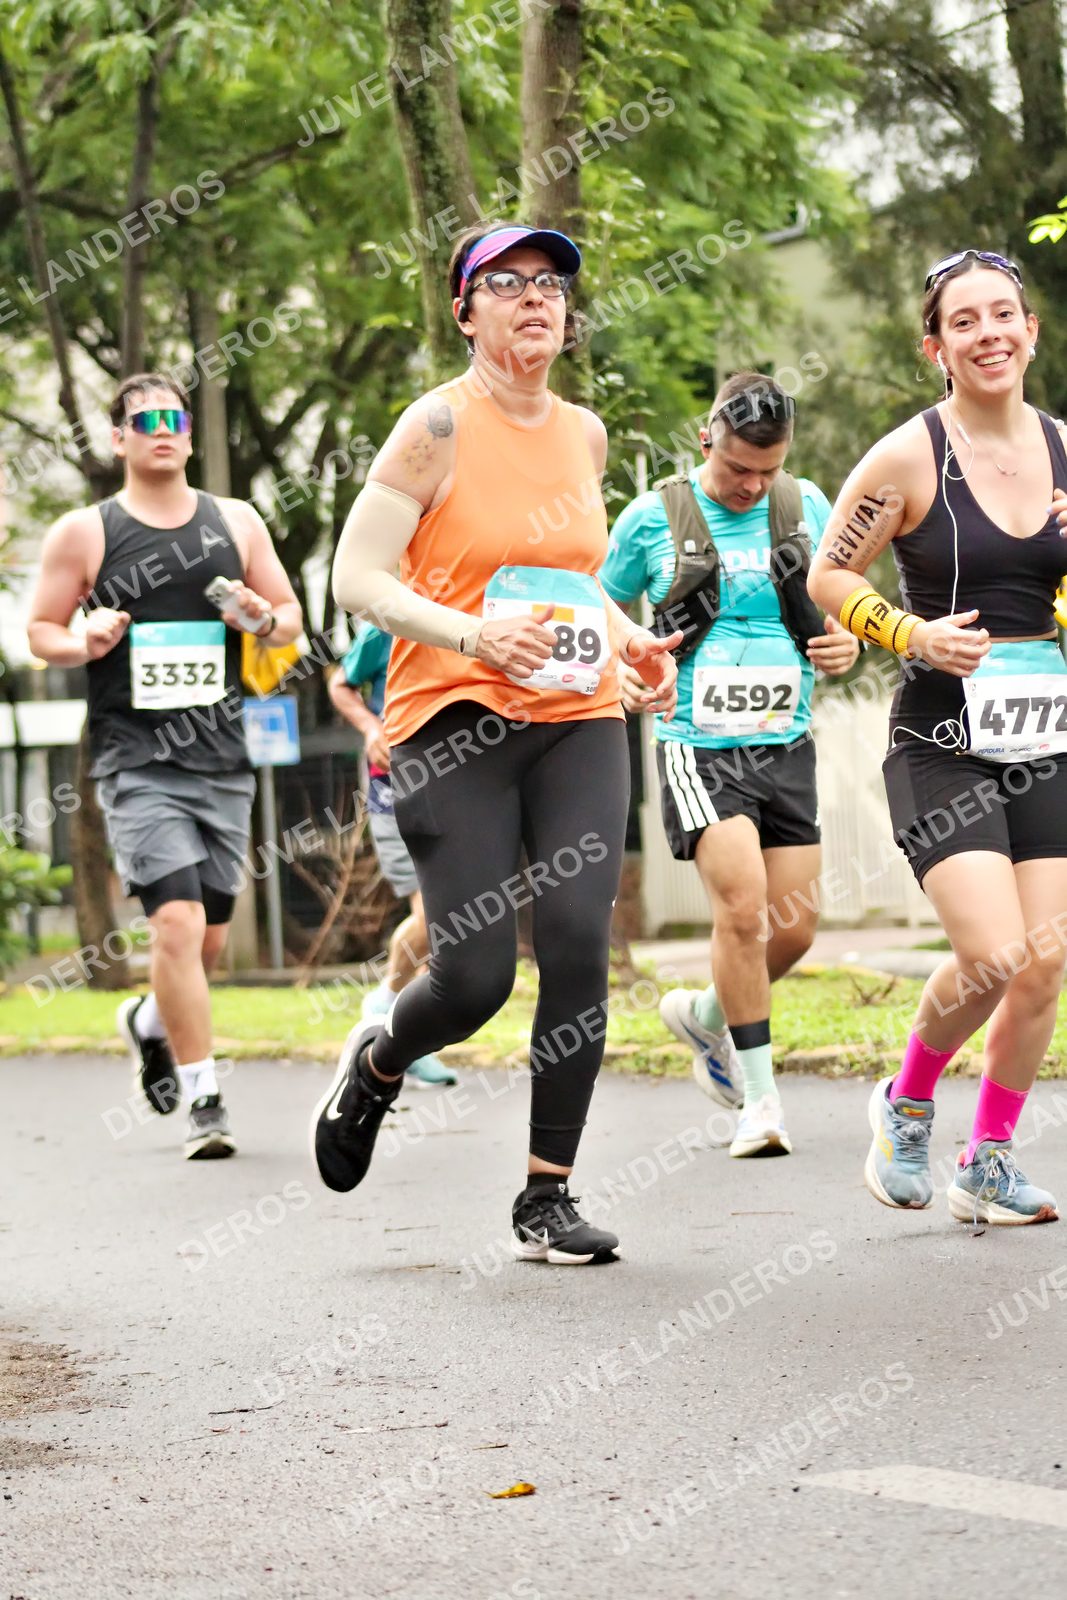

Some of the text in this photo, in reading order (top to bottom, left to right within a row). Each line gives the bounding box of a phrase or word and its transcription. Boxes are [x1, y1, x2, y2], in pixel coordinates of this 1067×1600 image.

[552, 625, 602, 665] 89
[141, 662, 218, 686] 3332
[702, 684, 793, 713] 4592
[980, 695, 1067, 736] 4772
